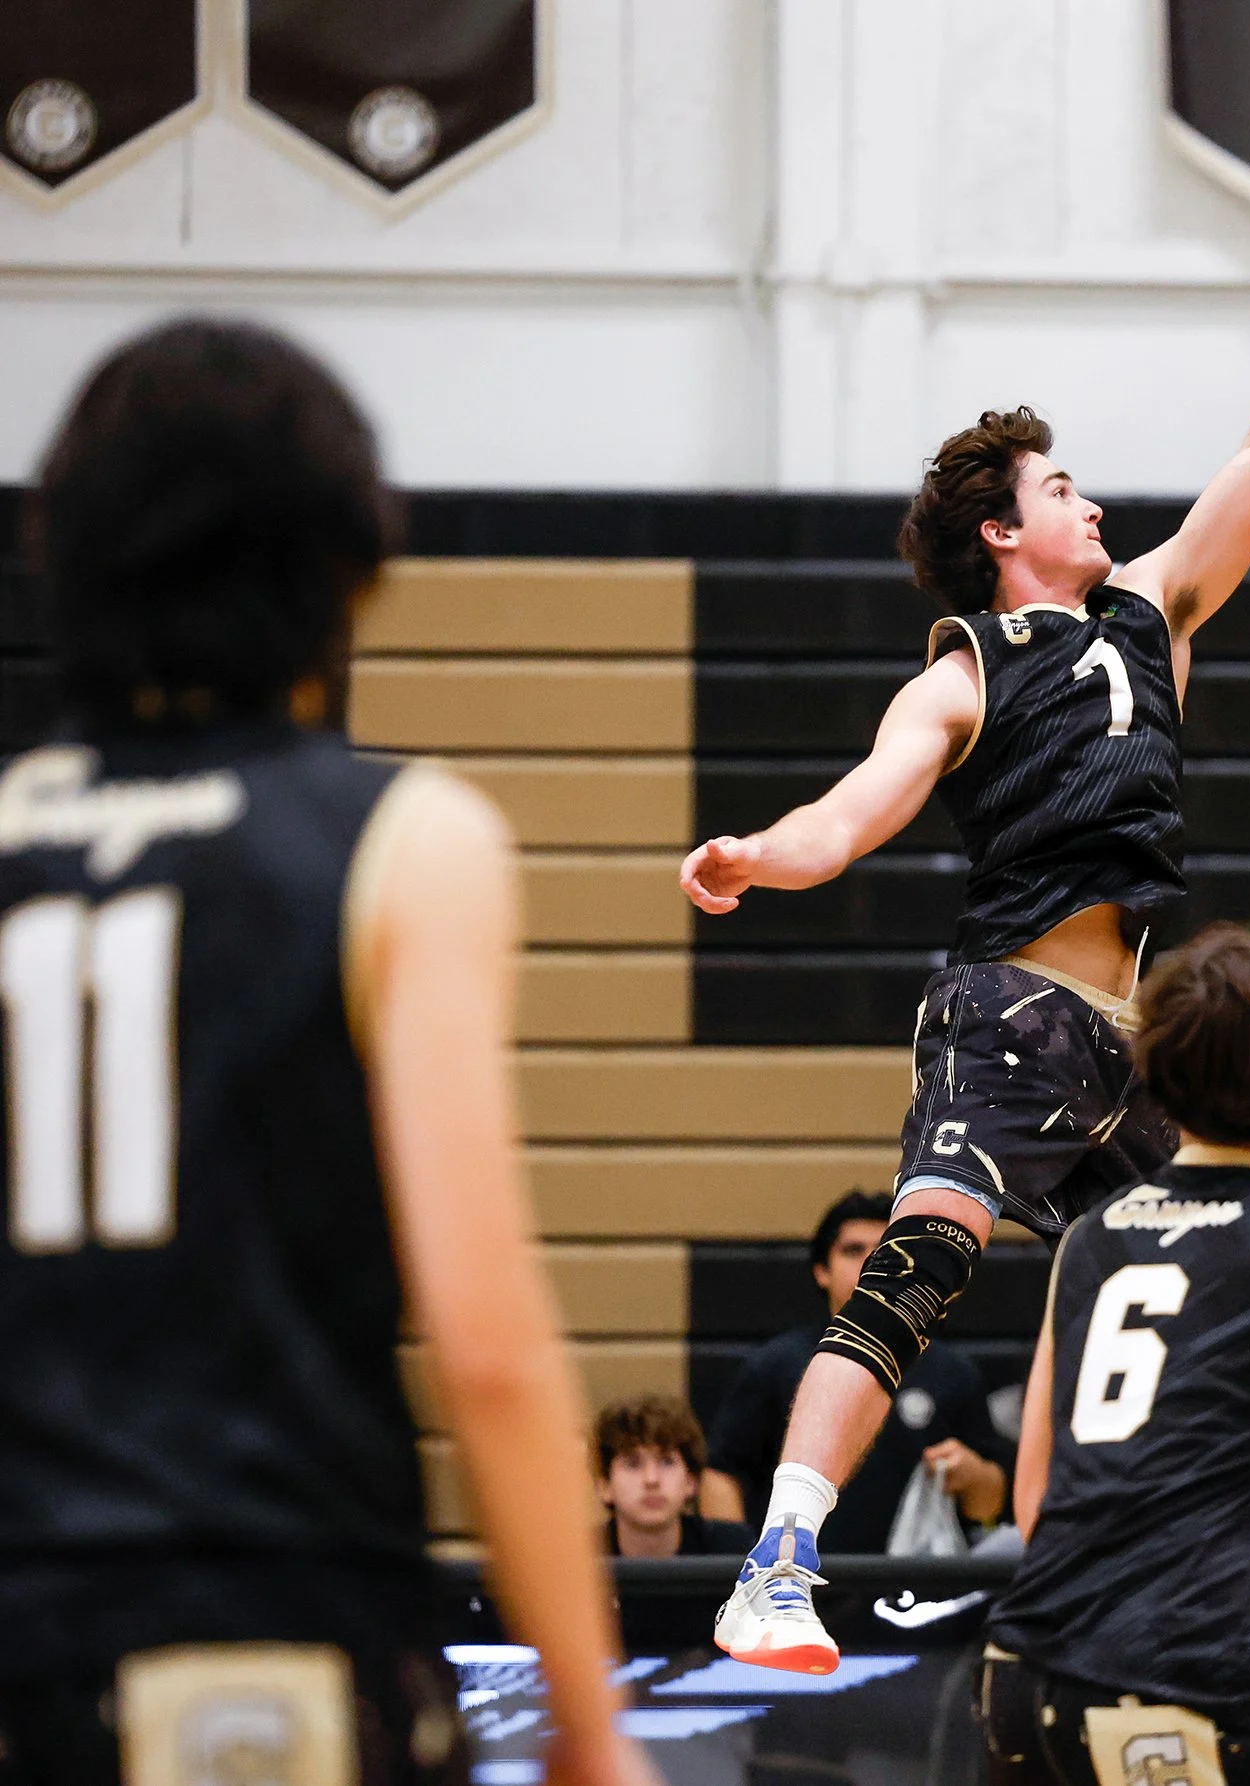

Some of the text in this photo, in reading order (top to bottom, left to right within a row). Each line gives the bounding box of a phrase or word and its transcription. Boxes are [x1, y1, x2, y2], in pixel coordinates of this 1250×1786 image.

[0, 886, 184, 1256] 11
[930, 1119, 970, 1157] C
[926, 1221, 977, 1254] copper
[1070, 1262, 1191, 1445] 6
